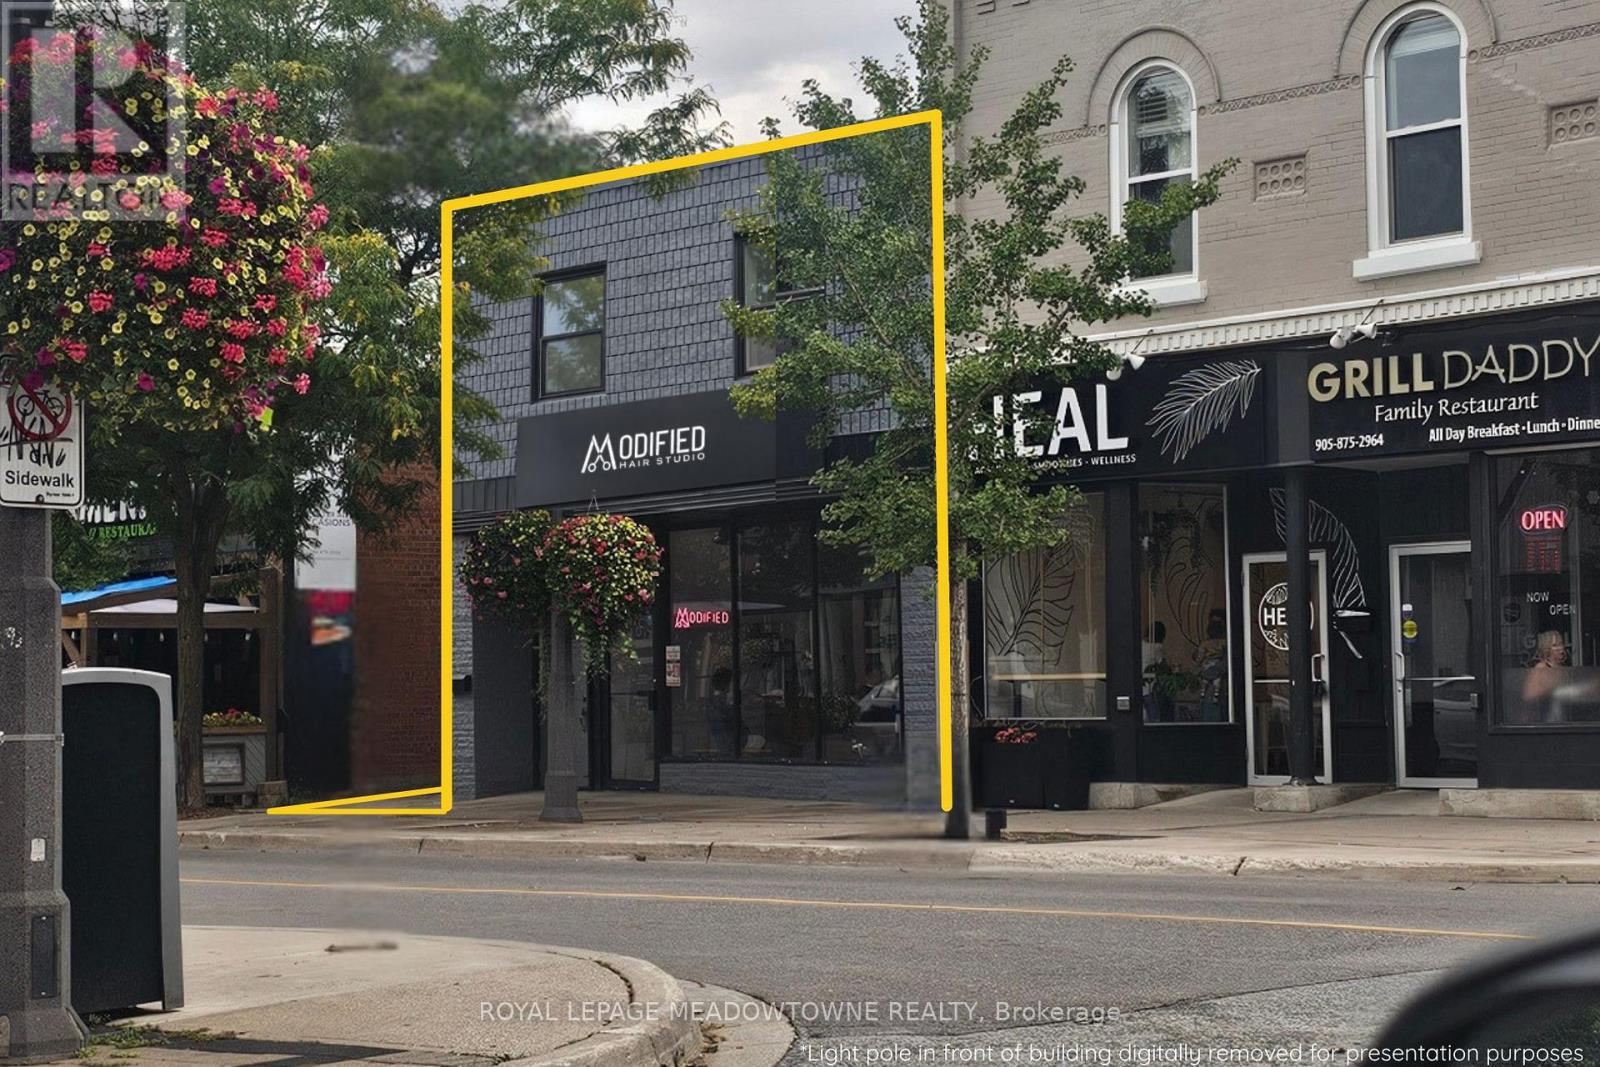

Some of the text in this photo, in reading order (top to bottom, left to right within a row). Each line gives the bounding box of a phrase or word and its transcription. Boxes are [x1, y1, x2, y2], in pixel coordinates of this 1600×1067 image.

[1307, 336, 1600, 402] GRILL DADDY
[1374, 391, 1540, 426] Family Restaurant
[1429, 416, 1600, 443] All Day Breakfast Lunch Dinne
[580, 425, 706, 474] MODIFIED
[1314, 433, 1385, 451] 905-875-2964
[619, 452, 706, 469] HAIR STUDIO
[1090, 453, 1137, 466] WELLNESS
[4, 470, 75, 488] Sidewalk
[1521, 510, 1565, 530] OPEN
[1526, 591, 1550, 602] NOW
[674, 607, 729, 629] MODIFIED
[1549, 603, 1577, 616] OPEN
